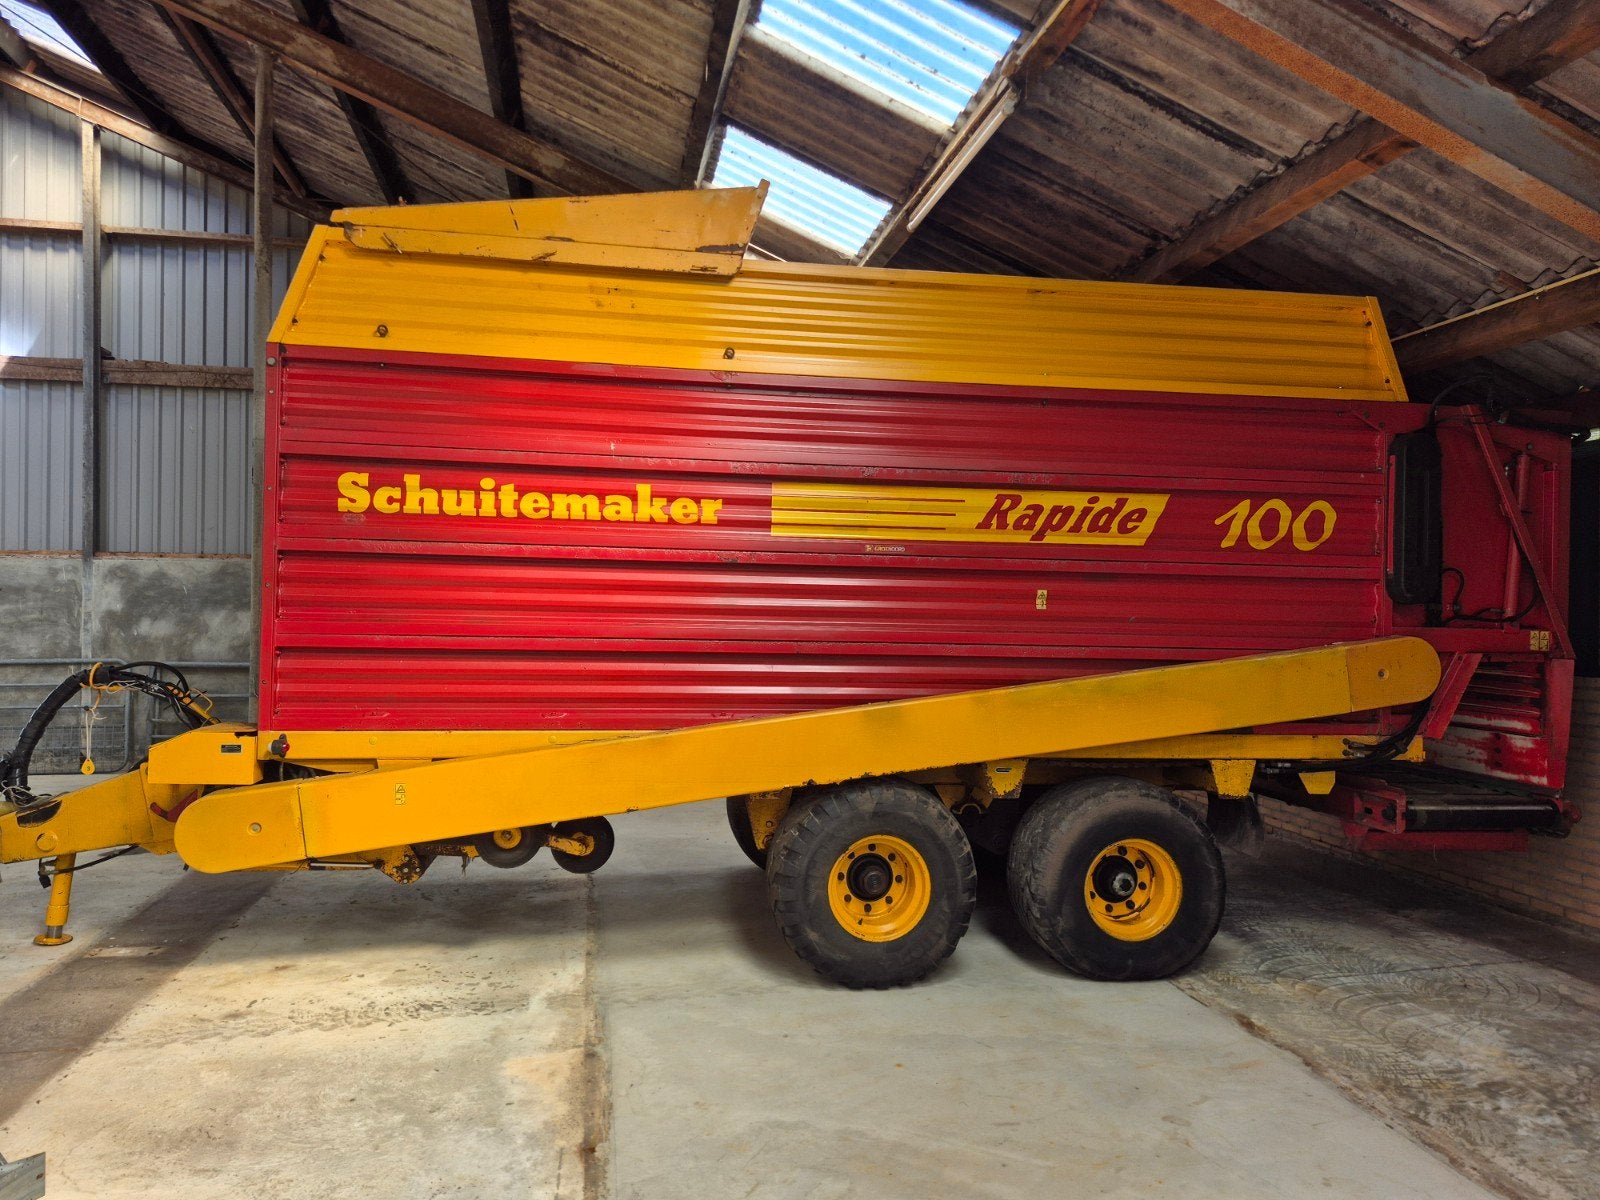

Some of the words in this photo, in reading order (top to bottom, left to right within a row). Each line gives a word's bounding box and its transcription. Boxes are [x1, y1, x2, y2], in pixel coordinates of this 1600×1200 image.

[337, 472, 723, 525] Schuitemaker
[975, 493, 1148, 541] Rapide
[1214, 498, 1337, 551] 100
